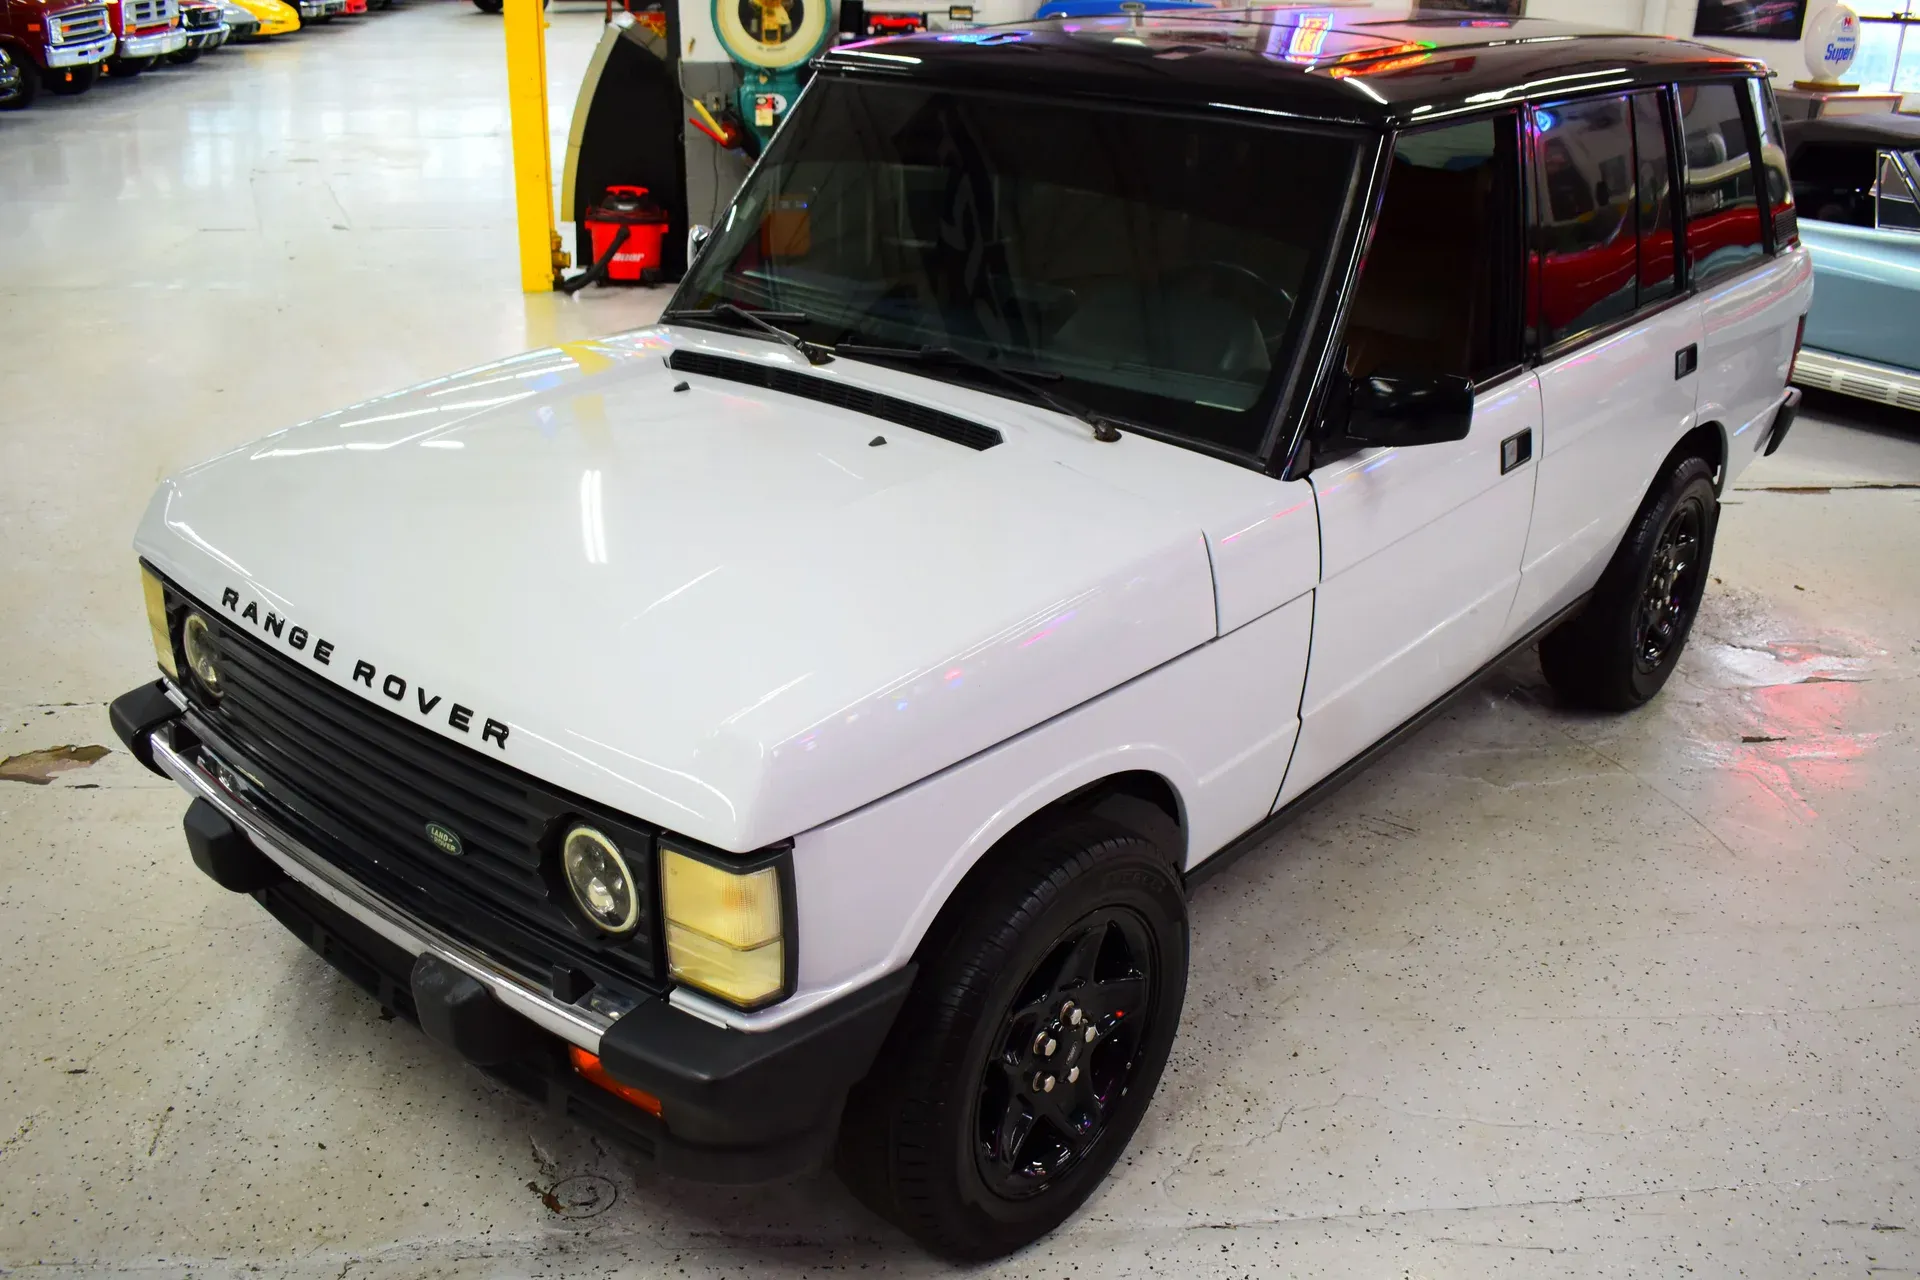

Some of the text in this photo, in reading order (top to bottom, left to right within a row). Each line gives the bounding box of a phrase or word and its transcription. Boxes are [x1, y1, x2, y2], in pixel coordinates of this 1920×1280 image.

[221, 586, 510, 750] RANGE ROVER
[433, 835, 456, 852] ROVER
